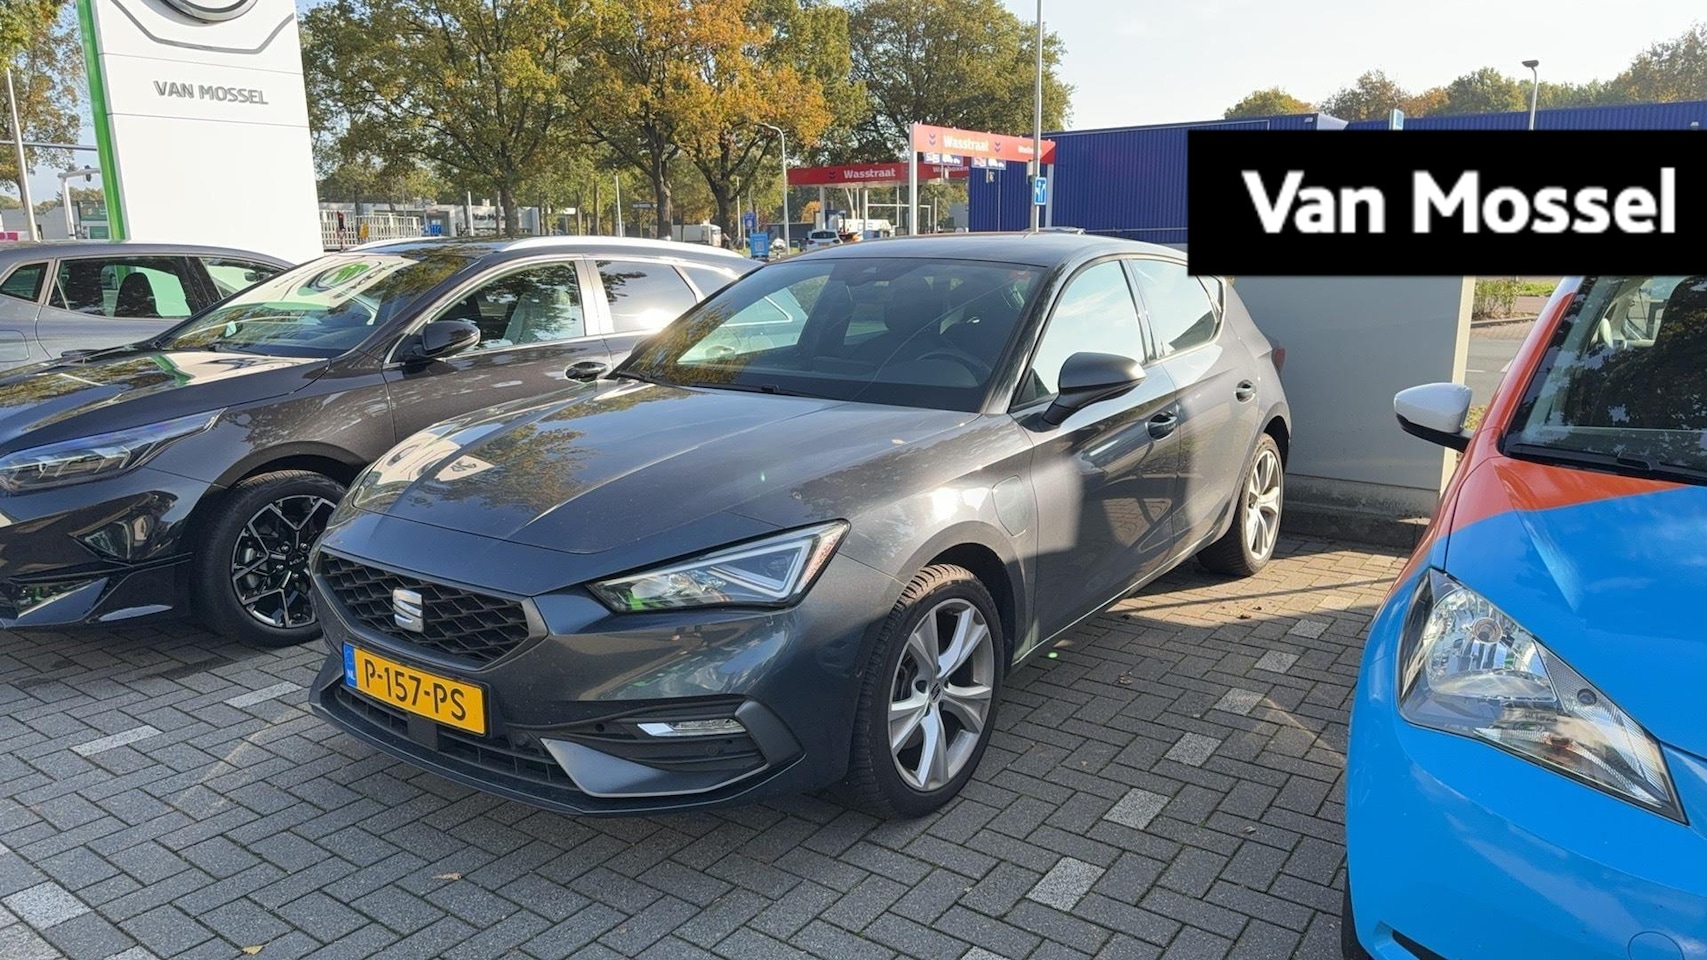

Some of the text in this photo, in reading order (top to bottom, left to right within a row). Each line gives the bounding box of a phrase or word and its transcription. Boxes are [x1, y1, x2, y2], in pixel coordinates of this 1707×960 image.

[153, 80, 269, 105] VAN MOSSEL
[943, 134, 989, 153] Wasstraat
[843, 167, 897, 180] Wasstraat
[363, 658, 467, 721] P-157-PS
